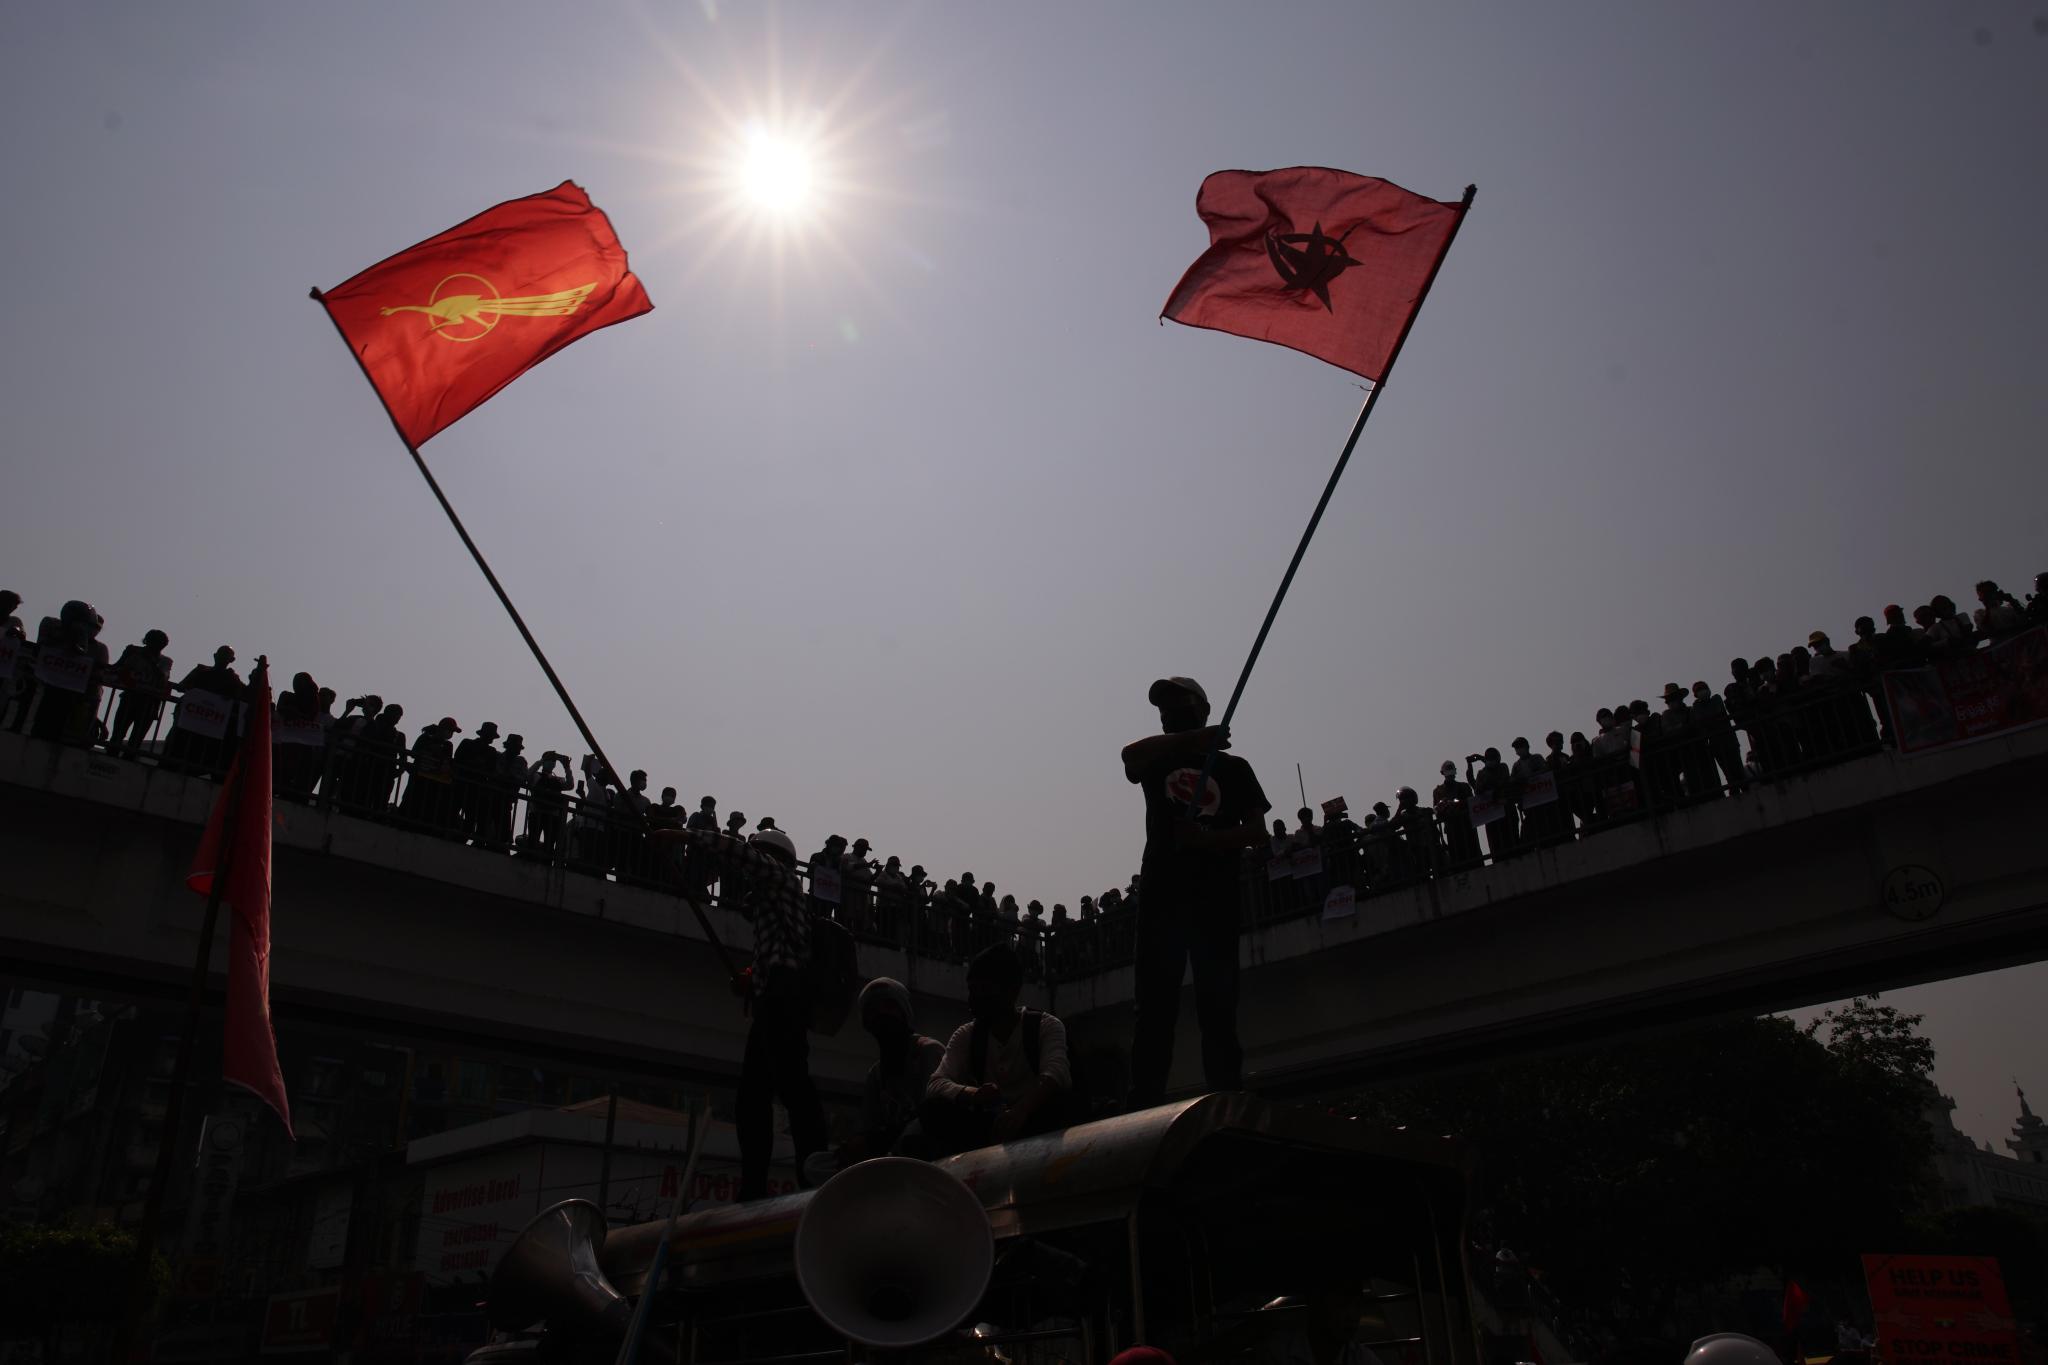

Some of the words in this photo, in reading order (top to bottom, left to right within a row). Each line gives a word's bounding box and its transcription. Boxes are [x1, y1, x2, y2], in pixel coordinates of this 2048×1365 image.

[43, 655, 88, 673] CRPH
[185, 703, 225, 723] CRPH
[1887, 880, 1938, 906] 4.5m
[1888, 1267, 1943, 1287] HELP
[1949, 1268, 1980, 1287] US
[1891, 1339, 1941, 1355] STOP
